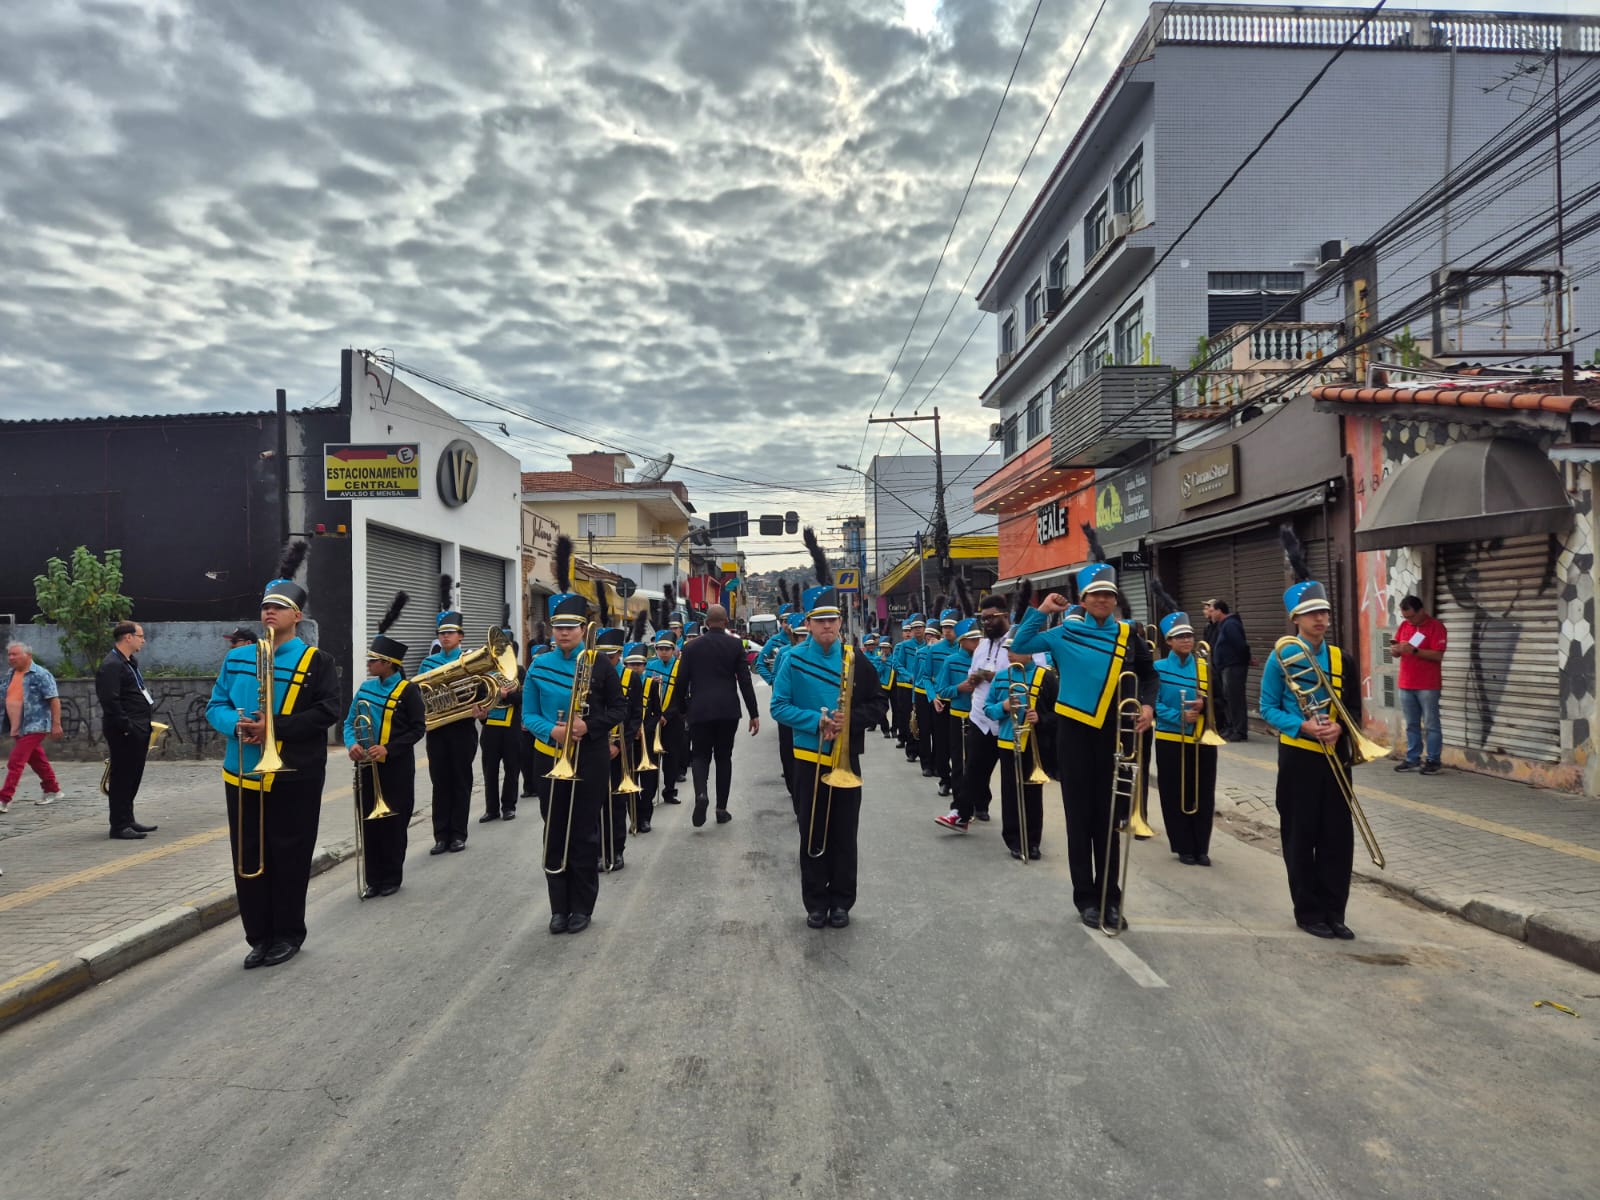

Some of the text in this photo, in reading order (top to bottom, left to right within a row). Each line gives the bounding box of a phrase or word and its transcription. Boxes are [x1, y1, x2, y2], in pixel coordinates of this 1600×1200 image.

[401, 449, 411, 462] E
[327, 467, 418, 479] ESTACIONAMENTO
[451, 450, 478, 501] V7
[344, 480, 401, 489] CENTRAL
[1037, 504, 1066, 545] REALE
